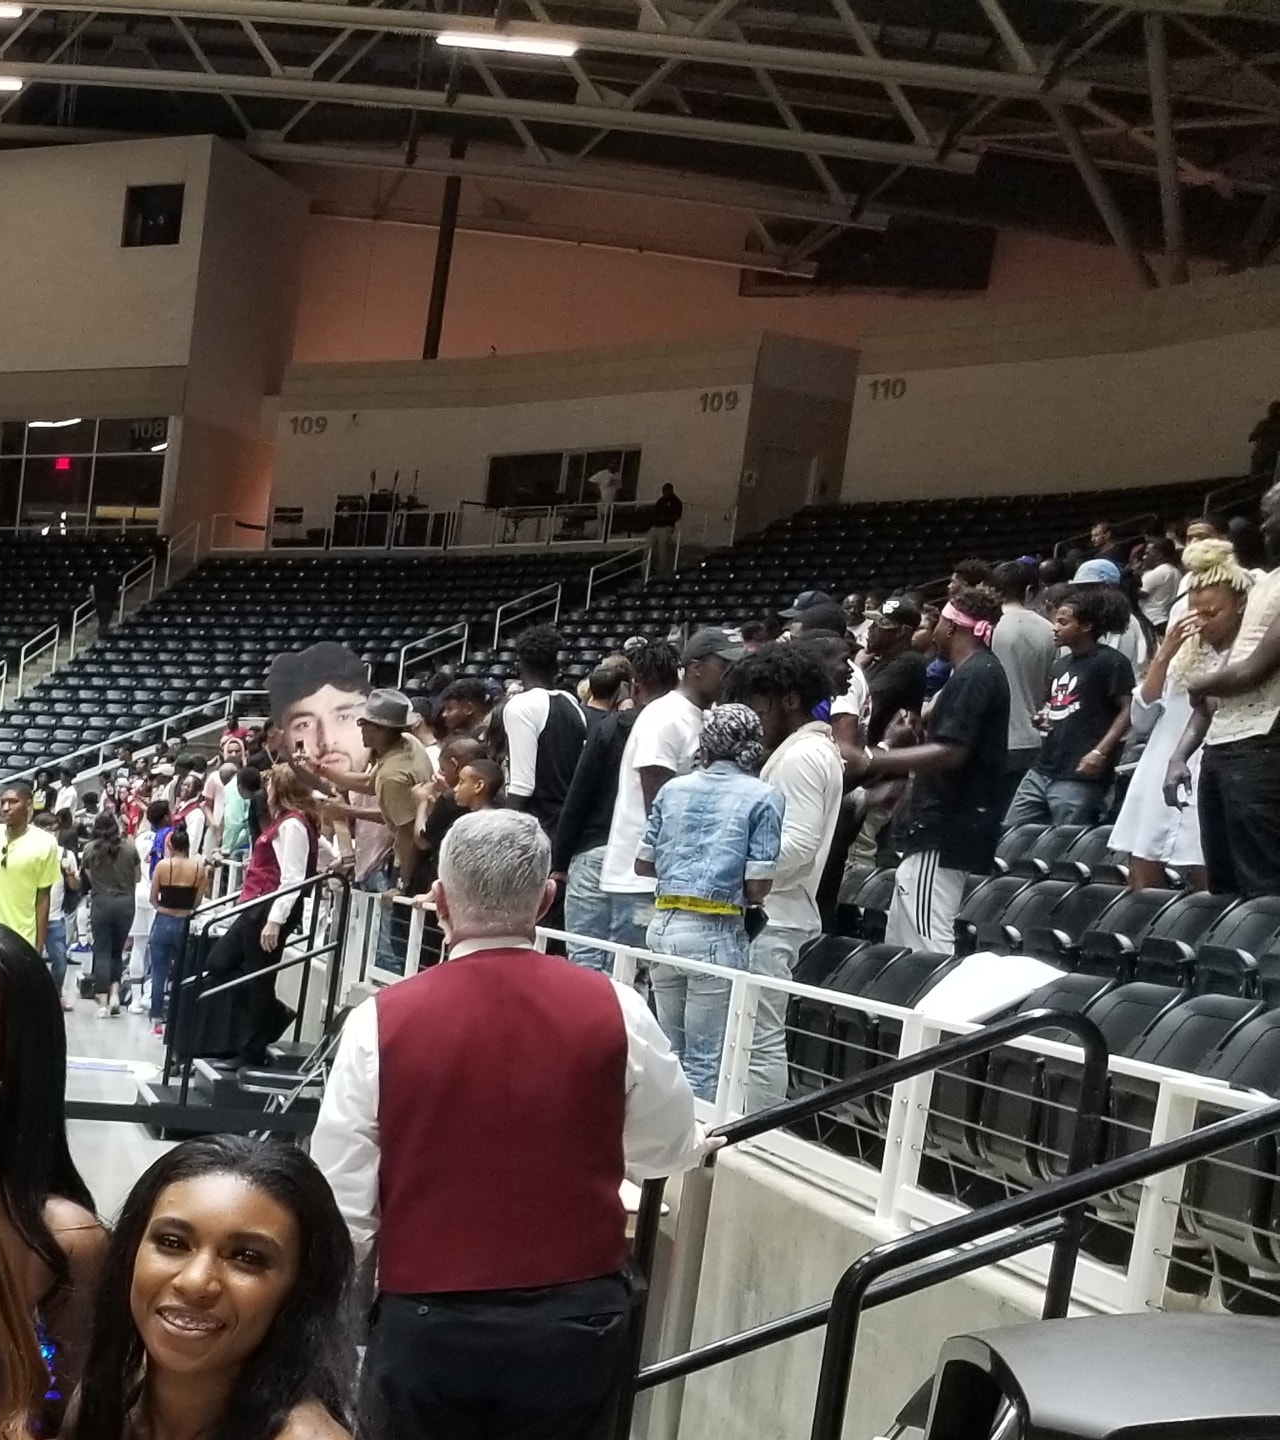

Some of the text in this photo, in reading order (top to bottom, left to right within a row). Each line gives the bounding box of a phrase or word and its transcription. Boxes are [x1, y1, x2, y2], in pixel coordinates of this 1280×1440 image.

[869, 378, 906, 400] 110
[699, 390, 738, 412] 109
[132, 422, 164, 439] 108
[289, 416, 328, 435] 109
